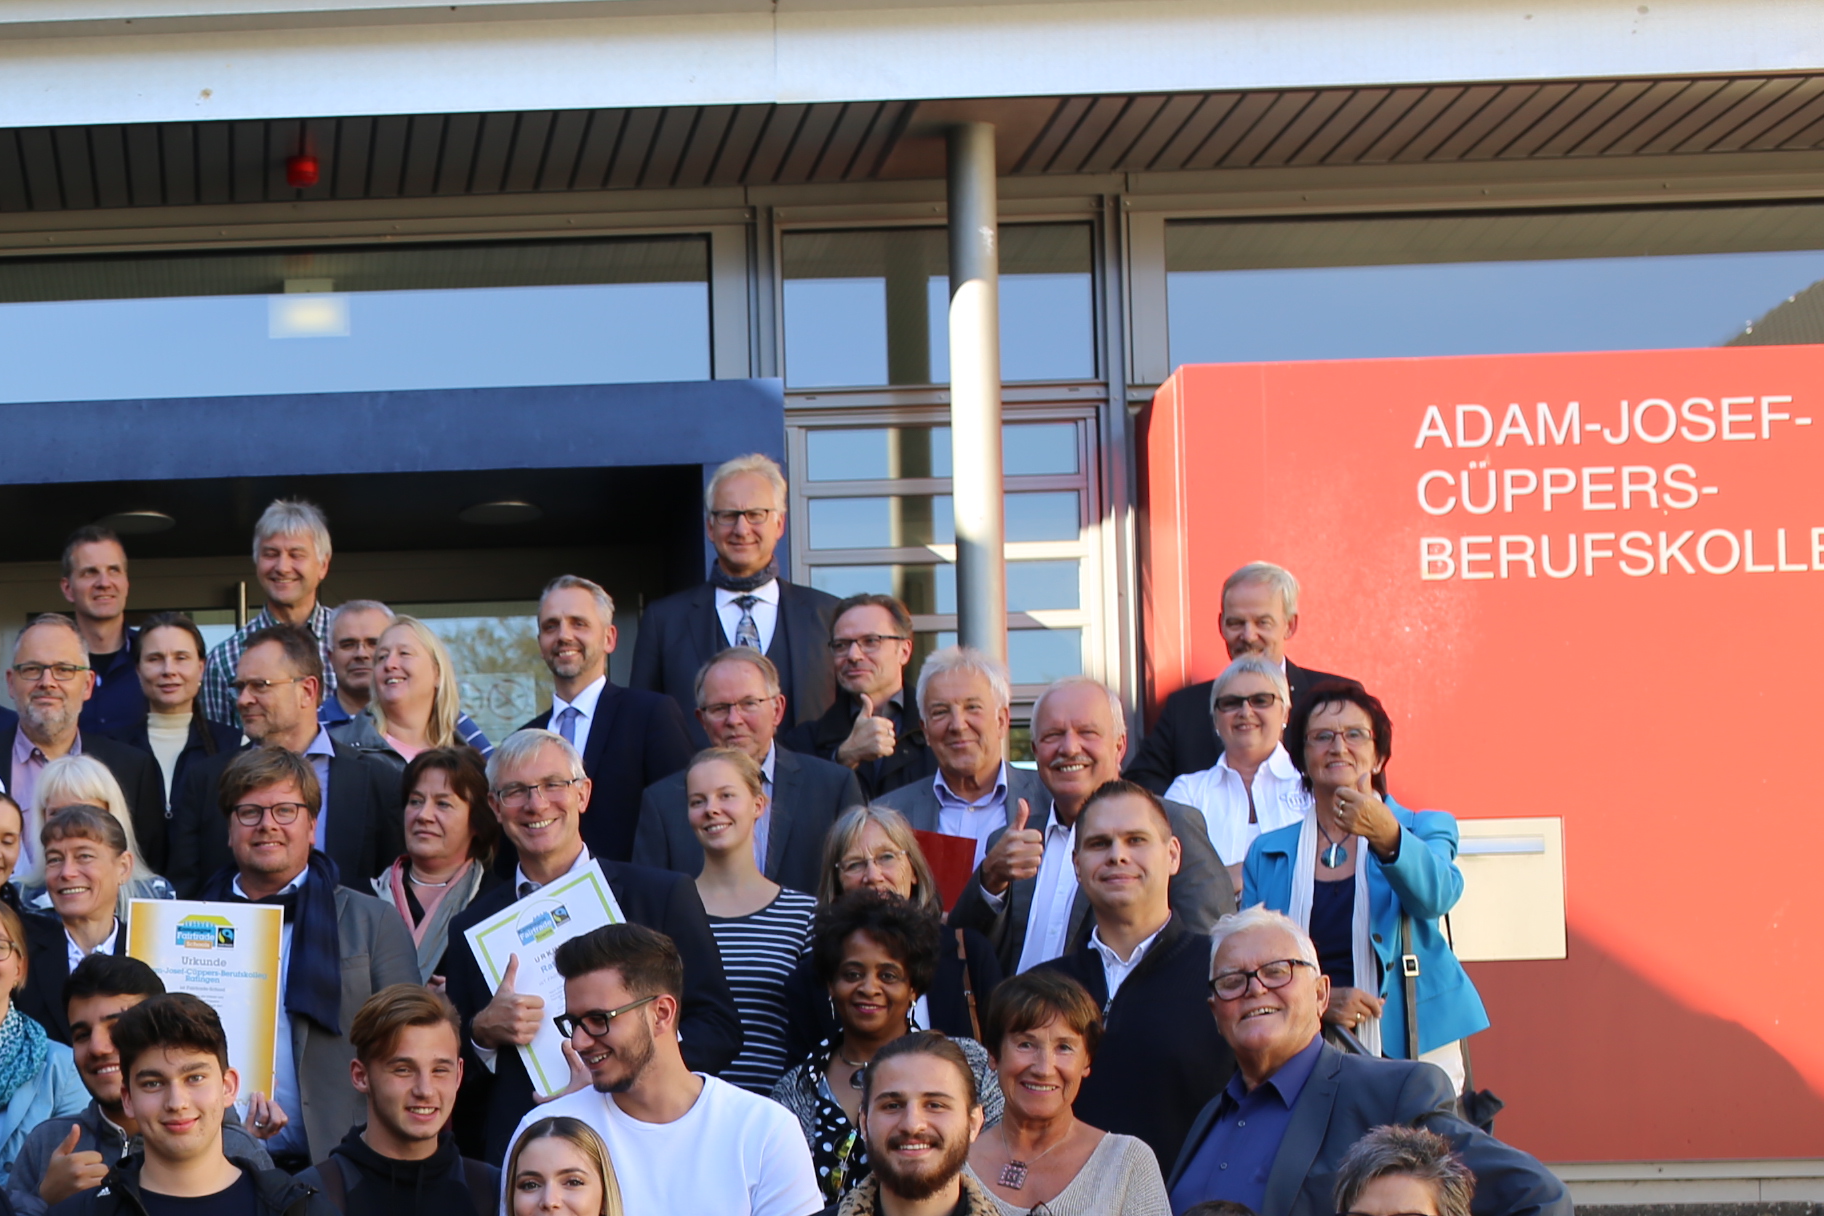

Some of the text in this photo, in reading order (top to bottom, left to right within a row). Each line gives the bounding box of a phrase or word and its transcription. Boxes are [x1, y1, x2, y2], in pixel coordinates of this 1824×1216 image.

[1414, 395, 1813, 449] ADAM-JOSEF-
[1416, 460, 1719, 516] CÜPPERS-
[176, 932, 215, 942] Fairtrade
[519, 919, 552, 941] Fairtrade
[181, 956, 227, 967] Urkunde
